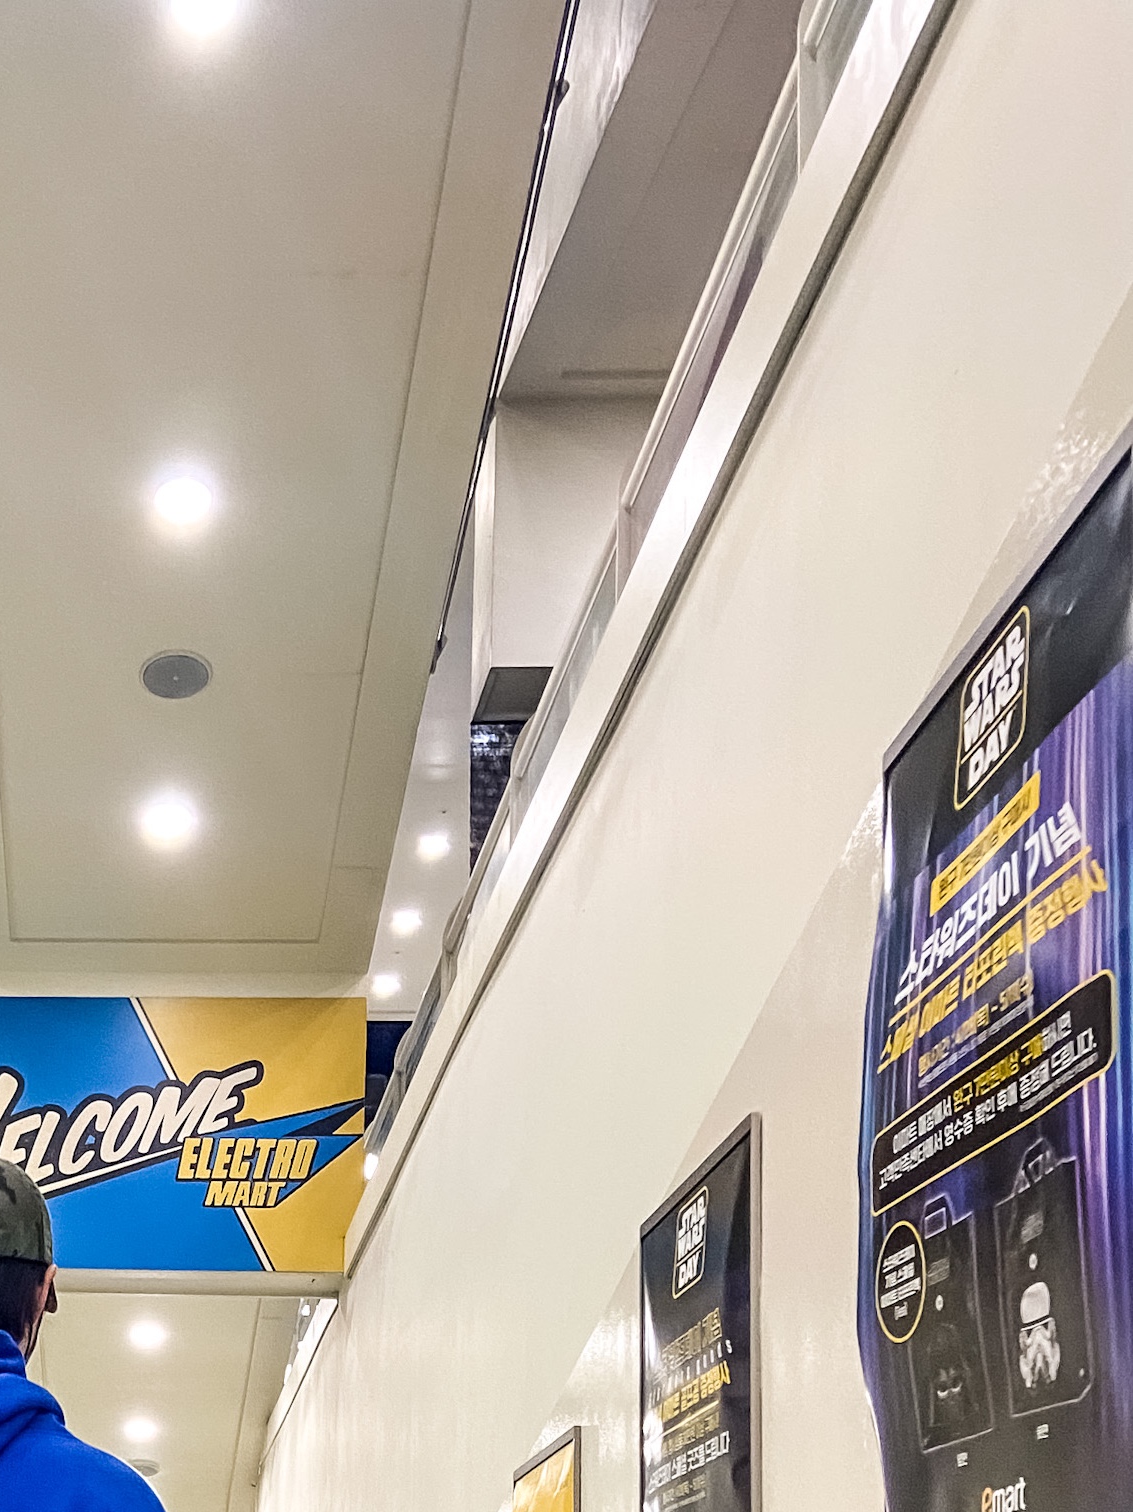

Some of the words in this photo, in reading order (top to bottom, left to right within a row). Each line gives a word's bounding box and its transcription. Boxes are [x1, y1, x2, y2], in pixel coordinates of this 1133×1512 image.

[964, 625, 1026, 723] STAR
[963, 651, 1025, 753] WARS
[967, 706, 1017, 792] DAY
[894, 851, 1019, 1005] 스타워즈데이
[1025, 800, 1083, 881] 기념
[944, 1110, 974, 1148] 영수증
[177, 1137, 318, 1180] ELECTRO
[204, 1180, 287, 1207] MART
[677, 1216, 706, 1261] WARS
[678, 1195, 707, 1240] STAR
[678, 1250, 702, 1289] DAY
